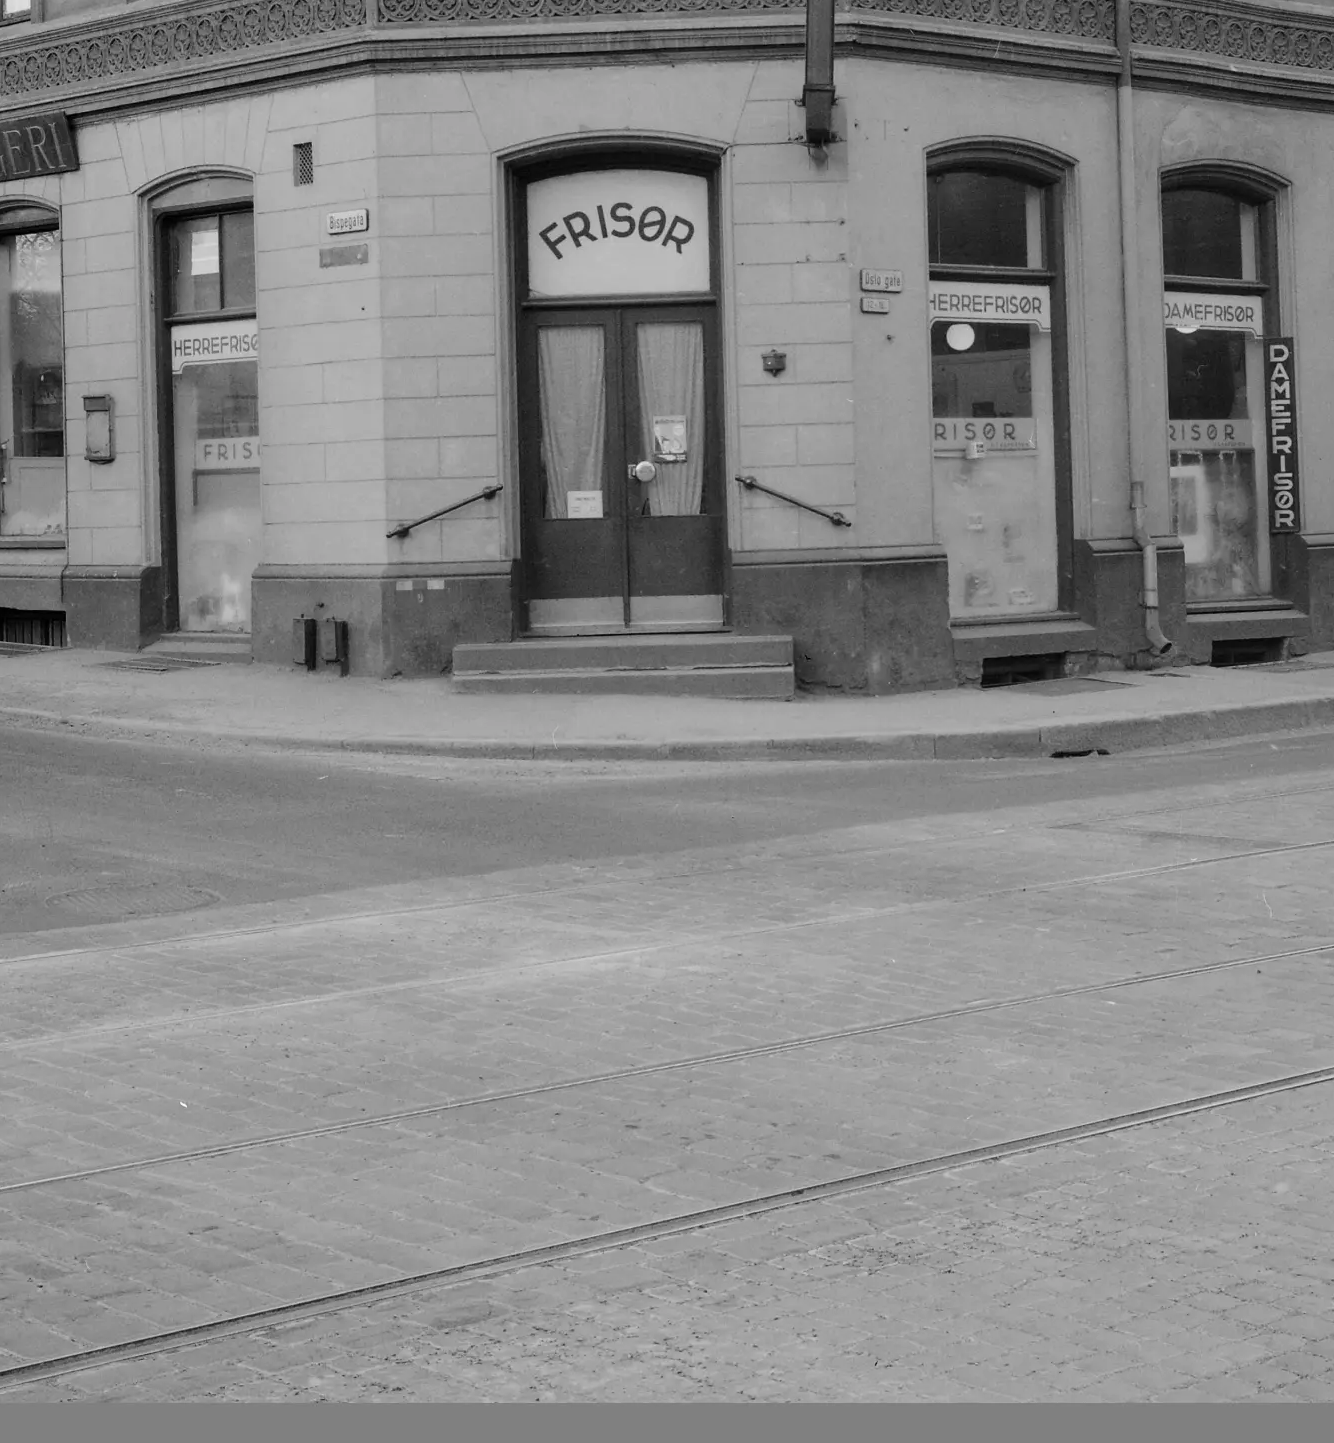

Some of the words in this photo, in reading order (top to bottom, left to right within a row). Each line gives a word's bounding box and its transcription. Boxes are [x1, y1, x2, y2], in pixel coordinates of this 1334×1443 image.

[329, 215, 364, 230] Bispegata
[538, 202, 695, 260] FRISØR
[865, 272, 882, 285] Oslo
[884, 275, 901, 289] gate
[934, 422, 1016, 441] RISØR
[1269, 344, 1294, 528] DAMEFRISØR
[203, 441, 261, 462] FRIS
